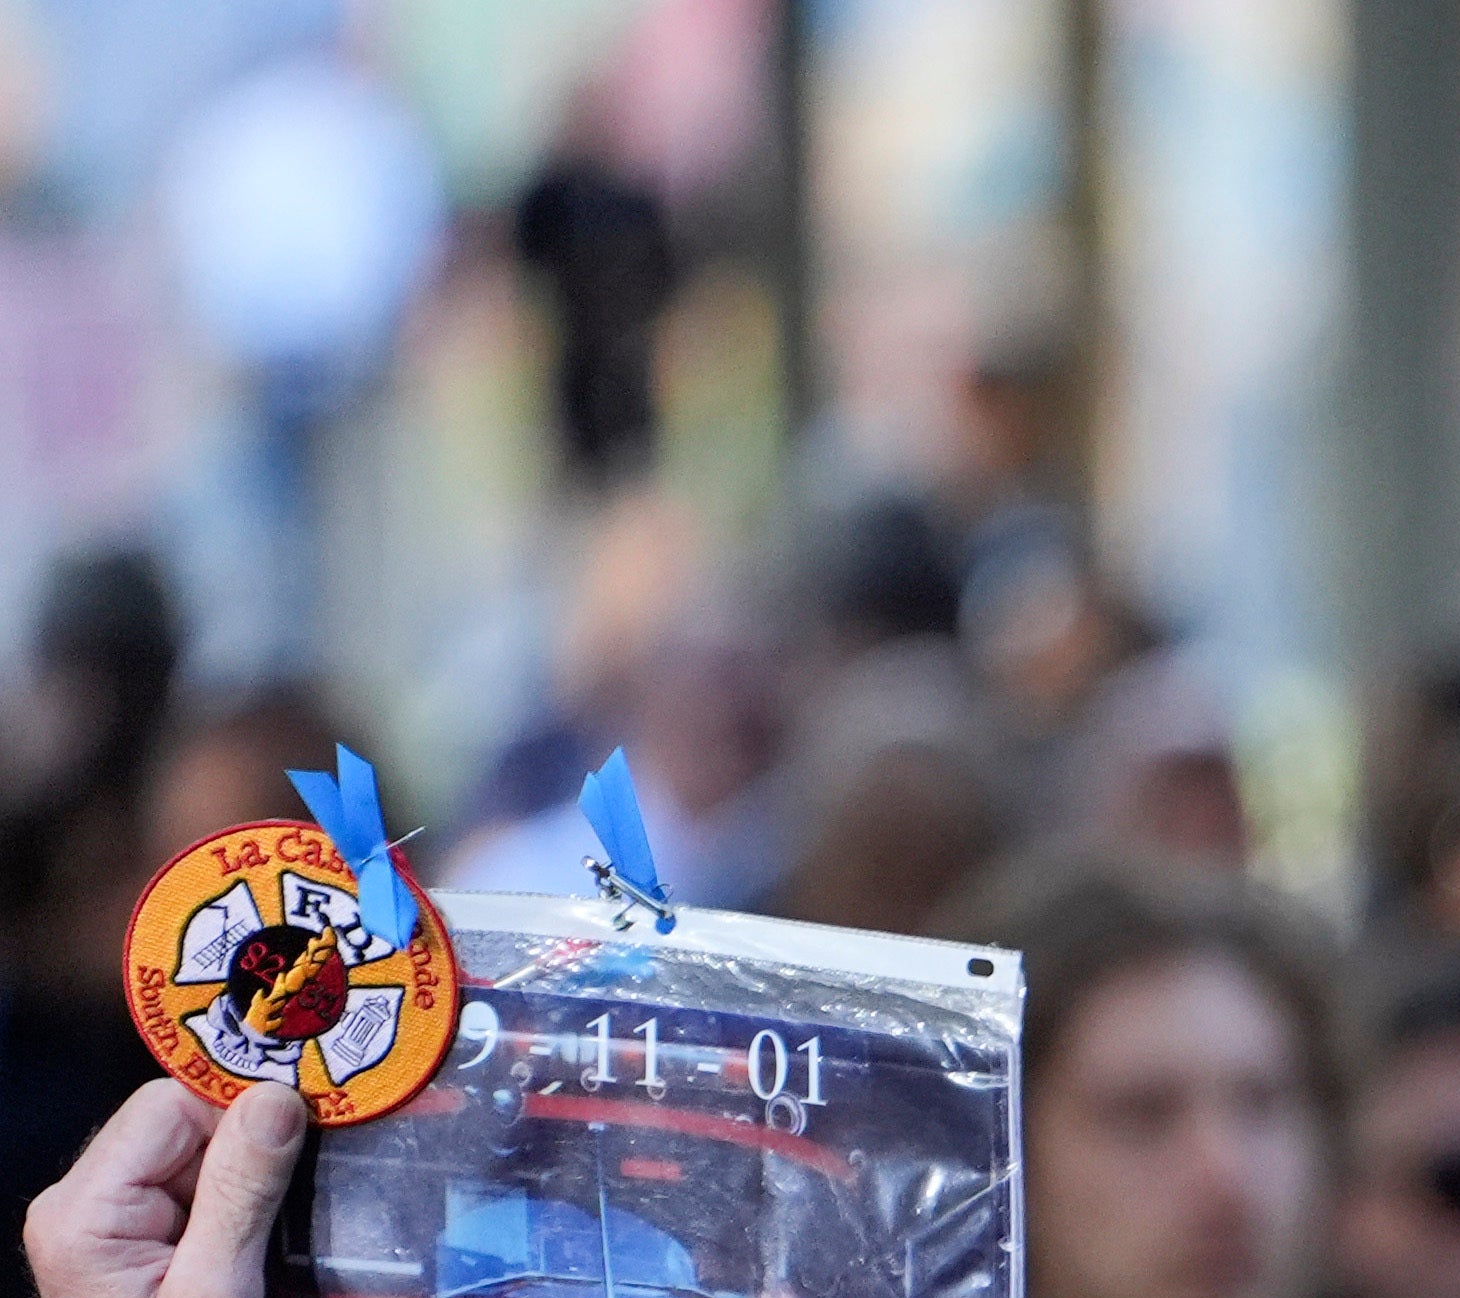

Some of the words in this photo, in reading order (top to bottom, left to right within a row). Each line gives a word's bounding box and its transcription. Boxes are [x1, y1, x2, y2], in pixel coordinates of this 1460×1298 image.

[211, 839, 272, 877] La
[275, 829, 357, 882] Cas
[240, 942, 286, 988] 82
[179, 1051, 248, 1101] Bro
[457, 1000, 500, 1070] 9
[586, 1012, 667, 1089] 11
[747, 1029, 828, 1106] 01
